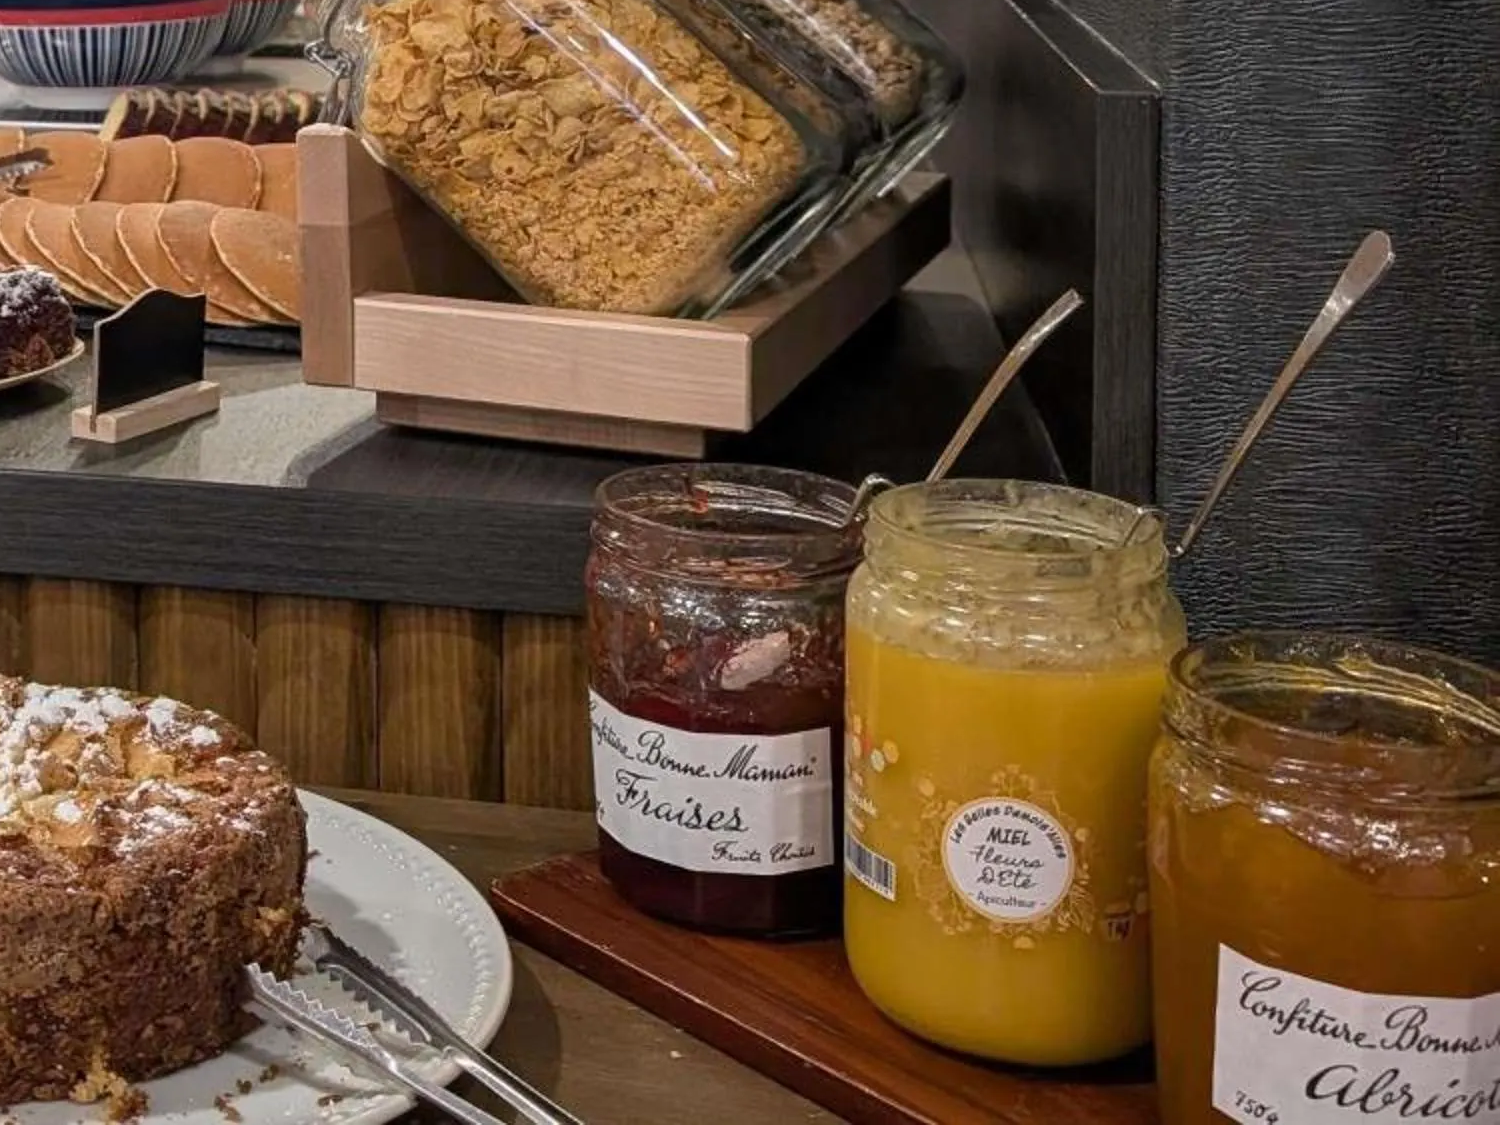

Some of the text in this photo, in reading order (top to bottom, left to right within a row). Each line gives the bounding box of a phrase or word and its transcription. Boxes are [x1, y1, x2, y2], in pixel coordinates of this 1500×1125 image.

[636, 731, 711, 778] Bonne
[713, 744, 813, 781] Maman
[615, 768, 749, 833] Fraises
[985, 826, 1032, 847] MIEL
[1238, 970, 1484, 1053] Confiture Bonne
